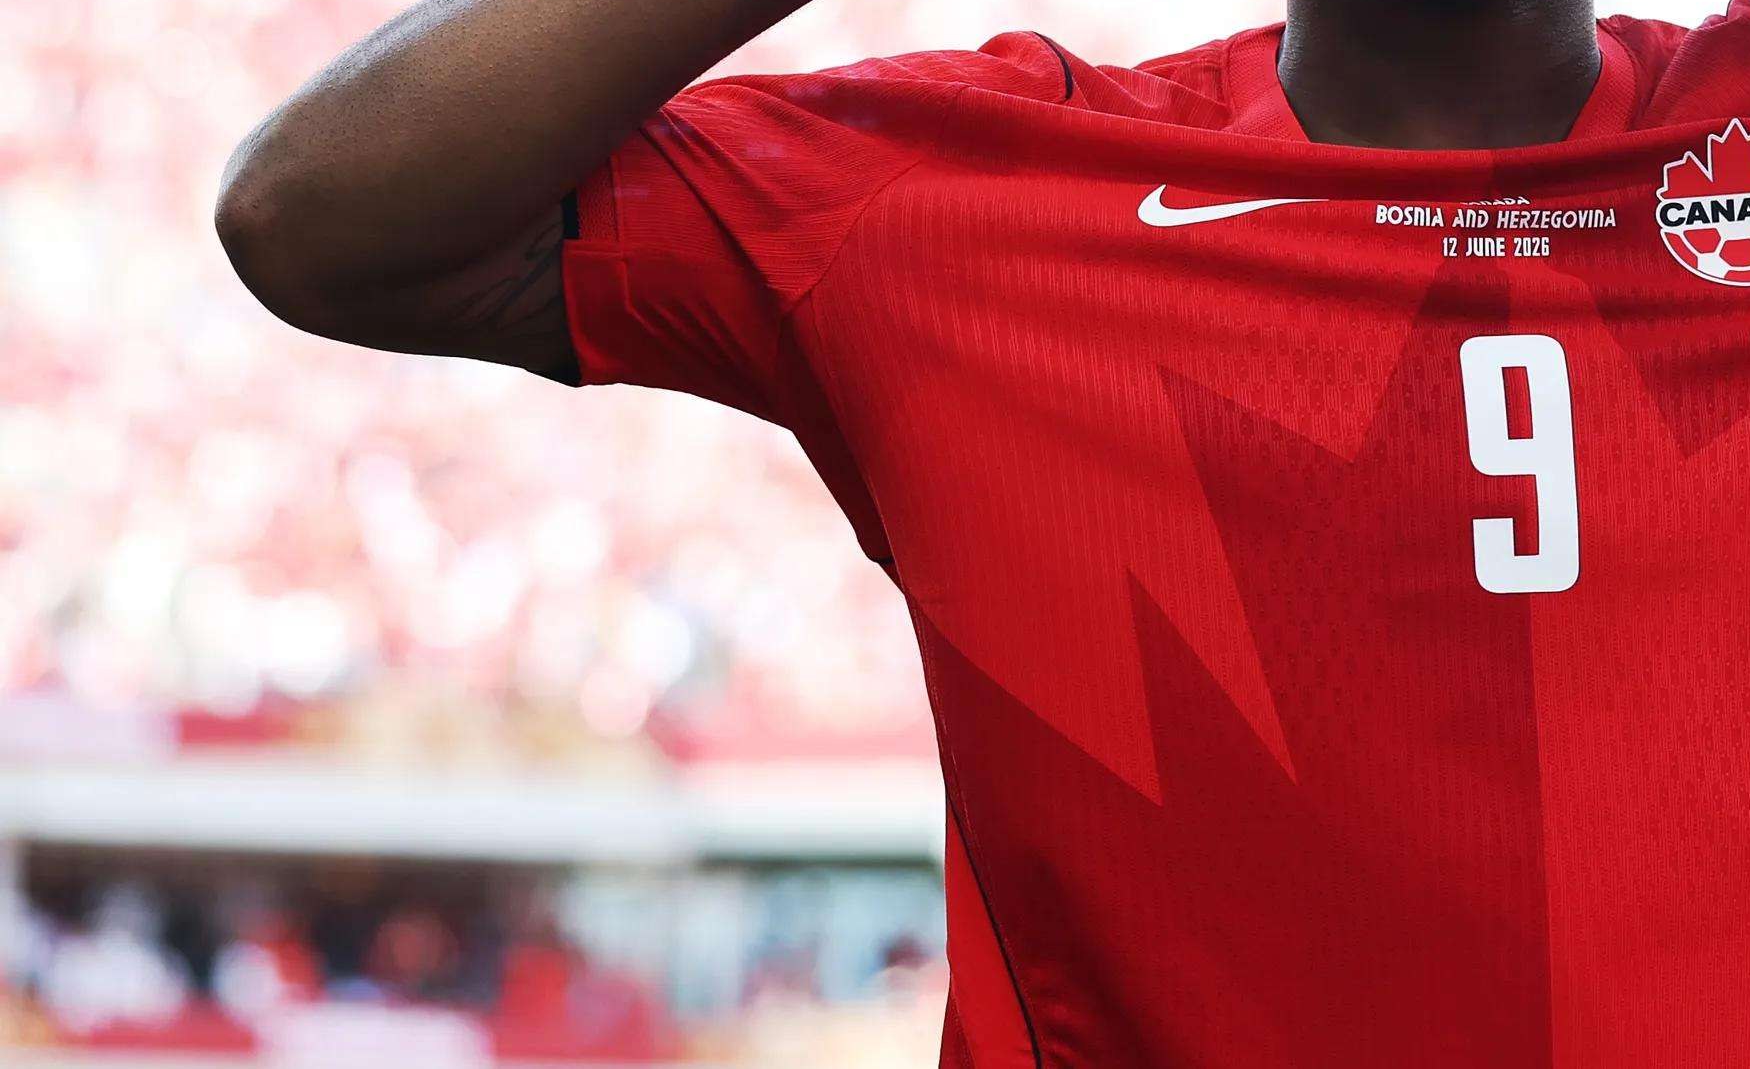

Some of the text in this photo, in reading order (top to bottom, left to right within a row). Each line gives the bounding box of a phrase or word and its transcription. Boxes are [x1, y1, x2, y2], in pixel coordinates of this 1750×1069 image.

[1375, 204, 1617, 229] BOSNIA AND HERZEGOVINA
[1442, 236, 1550, 257] 12 JUNE 2026
[1459, 334, 1580, 594] 9
